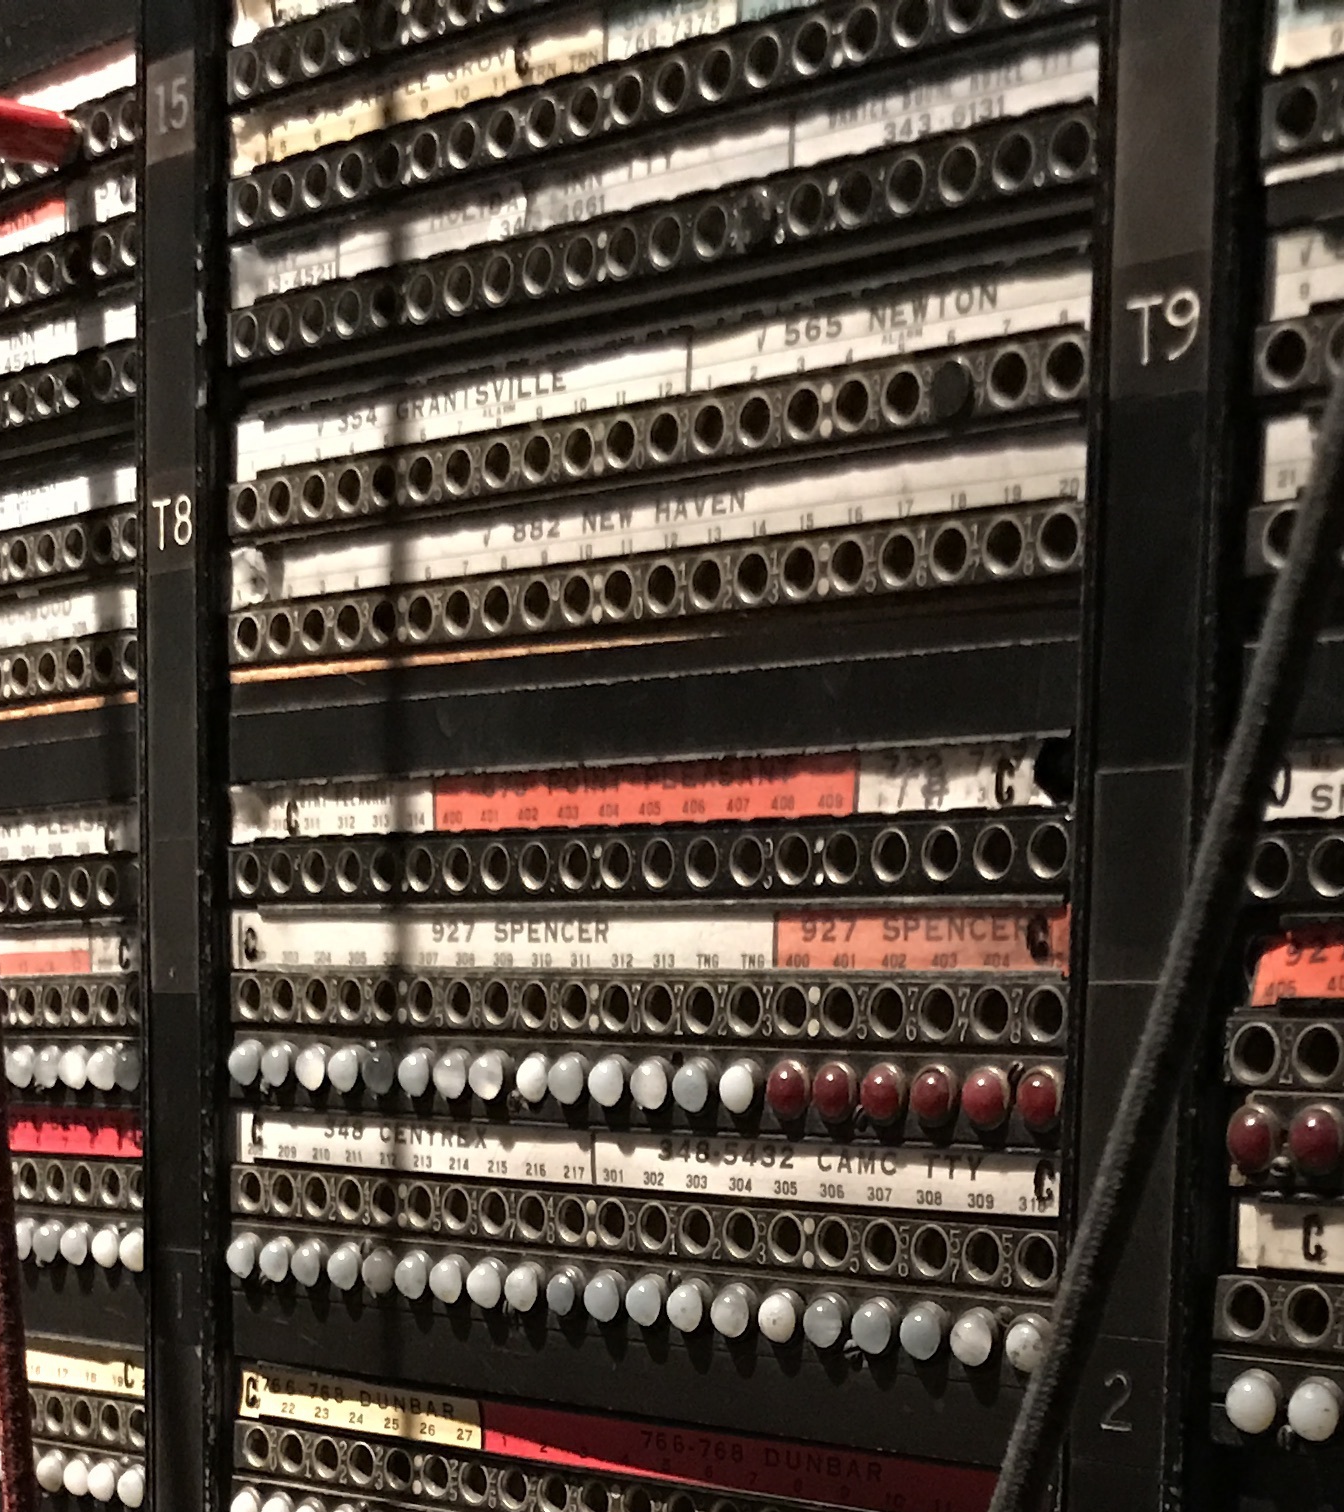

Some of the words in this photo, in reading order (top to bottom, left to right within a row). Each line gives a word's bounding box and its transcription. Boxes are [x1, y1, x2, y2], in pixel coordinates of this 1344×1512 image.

[568, 49, 599, 70] TRN
[155, 77, 191, 134] 15
[785, 316, 843, 346] 565
[869, 284, 998, 332] NEWTON
[1003, 319, 1012, 335] 7
[1125, 288, 1202, 366] T9
[337, 407, 378, 434] 354
[395, 371, 567, 420] GRANTSVILLE
[616, 390, 626, 405] 11
[658, 382, 673, 398] 12
[150, 494, 194, 552] T8
[513, 518, 561, 545] 882
[582, 509, 633, 536] NEW
[655, 489, 746, 524] HAVEN
[753, 519, 767, 537] 14
[800, 513, 814, 530] 15
[898, 499, 914, 518] 17
[1060, 477, 1080, 497] 20
[431, 920, 476, 944] 927
[494, 920, 609, 945] SPENCER
[801, 918, 855, 943] 927
[118, 937, 130, 969] C
[611, 954, 634, 969] 312
[379, 1122, 488, 1149] CENTREX
[413, 1153, 432, 1169] 213
[449, 1156, 469, 1172] 214
[487, 1159, 508, 1174] 215
[525, 1162, 547, 1178] 216
[563, 1164, 585, 1180] 217
[816, 1146, 898, 1177] CAMC
[922, 1152, 984, 1182] TTY
[603, 1167, 624, 1183] 301
[643, 1169, 664, 1187] 302
[685, 1174, 708, 1189] 303
[728, 1177, 752, 1193] 304
[773, 1180, 798, 1196] 305
[820, 1183, 845, 1200] 306
[867, 1186, 893, 1202] 307
[916, 1189, 943, 1206] 308
[967, 1193, 995, 1210] 309
[1301, 1213, 1326, 1264] C
[123, 1359, 135, 1389] C
[359, 1389, 455, 1419] DUNBAR
[1102, 1372, 1132, 1431] 2
[281, 1401, 295, 1415] 22
[314, 1406, 329, 1419] 23
[348, 1412, 364, 1425] 24
[384, 1416, 400, 1431] 25
[419, 1421, 436, 1436] 26
[456, 1427, 473, 1442] 27
[639, 1429, 744, 1463] 766-768
[765, 1447, 884, 1482] DUNBAR
